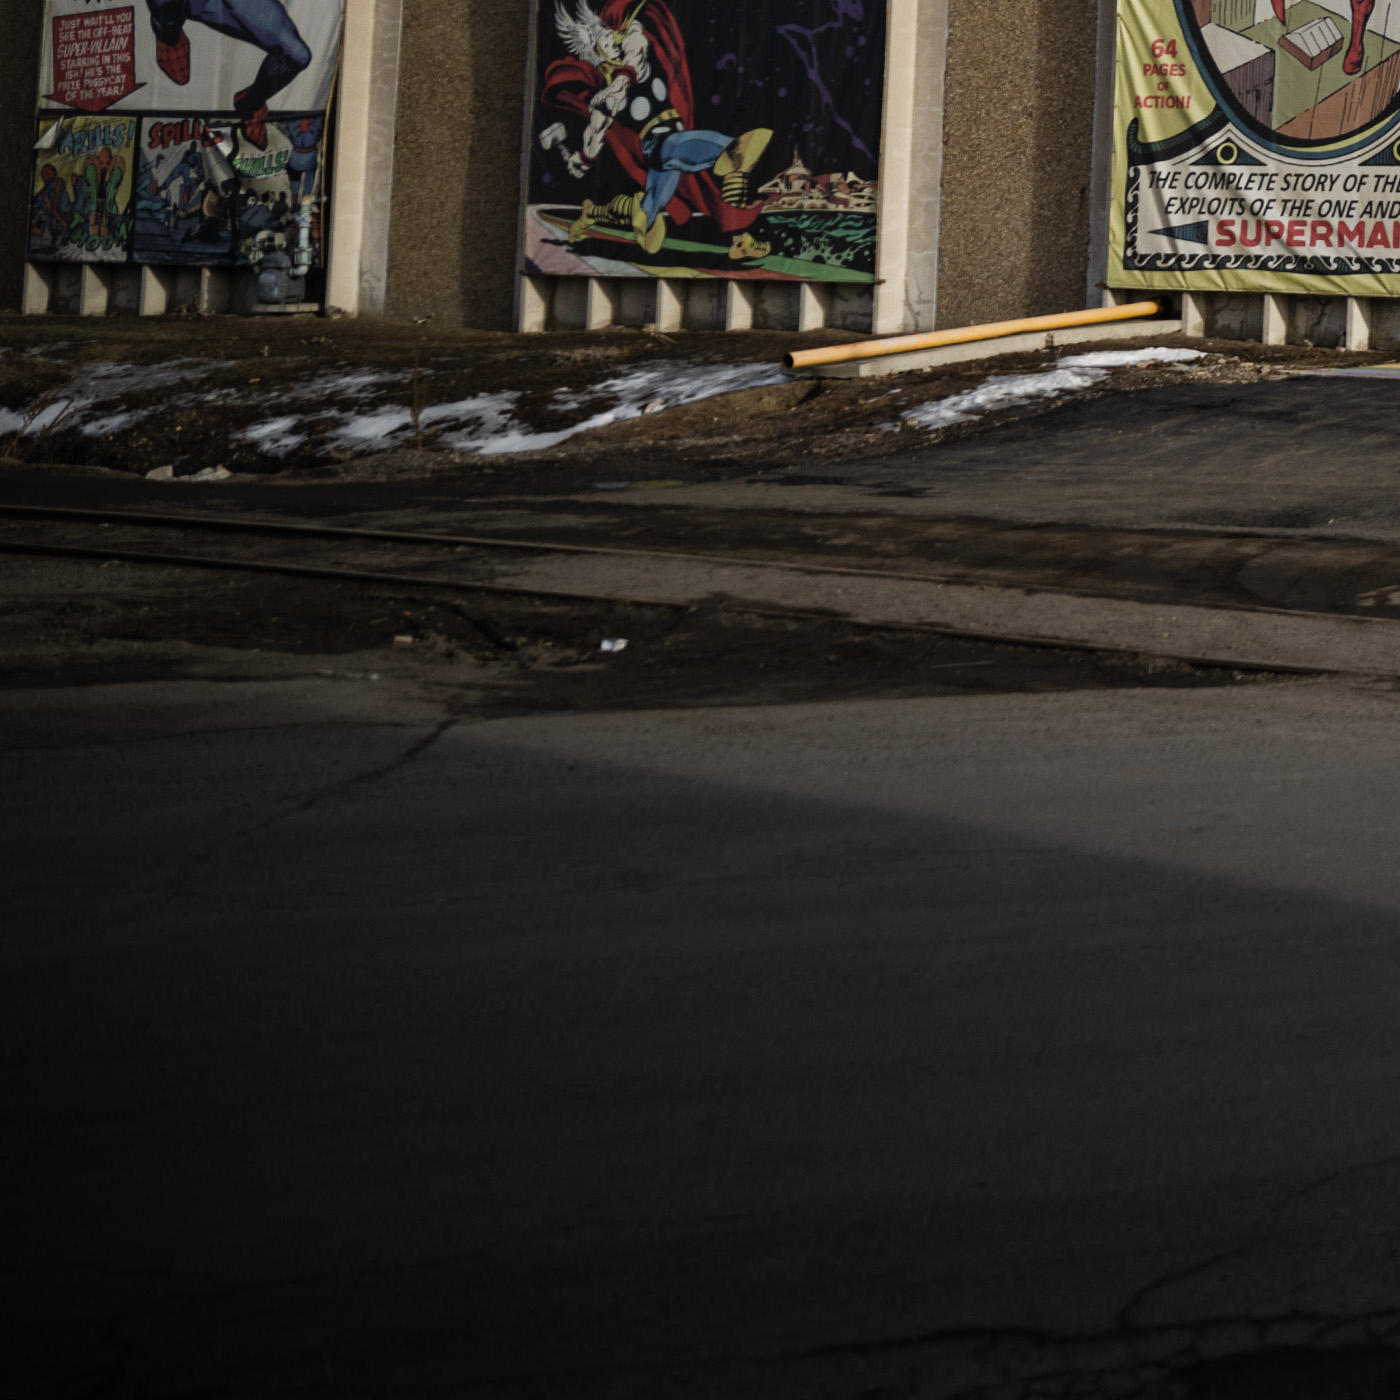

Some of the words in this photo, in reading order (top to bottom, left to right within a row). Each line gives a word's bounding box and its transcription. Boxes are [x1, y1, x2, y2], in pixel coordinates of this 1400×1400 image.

[58, 18, 81, 31] JUST
[115, 11, 132, 23] YOU
[59, 31, 75, 43] SEE
[77, 29, 91, 40] THE
[92, 23, 132, 38] OFF-BEAT
[57, 37, 129, 60] SUPER-VILLAIN
[1151, 38, 1178, 58] 64
[60, 56, 100, 71] STARRING
[102, 54, 111, 65] IN
[112, 52, 131, 63] THIS
[105, 64, 122, 75] THE
[1143, 63, 1186, 77] PAGES
[57, 80, 81, 92] PRIZE
[83, 74, 126, 89] PUSSYCAT
[1157, 81, 1170, 91] OF
[65, 91, 77, 103] OF
[79, 89, 93, 101] THE
[96, 84, 124, 99] YEAR!
[1134, 95, 1191, 109] ACTION!
[1149, 171, 1181, 189] THE
[1184, 171, 1278, 191] COMPLETE
[1281, 173, 1341, 192] STORY
[1343, 174, 1369, 192] OF
[1165, 197, 1246, 216] EXPLOITS
[1250, 198, 1276, 217] OF
[1280, 199, 1315, 217] THE
[1318, 200, 1358, 218] ONE
